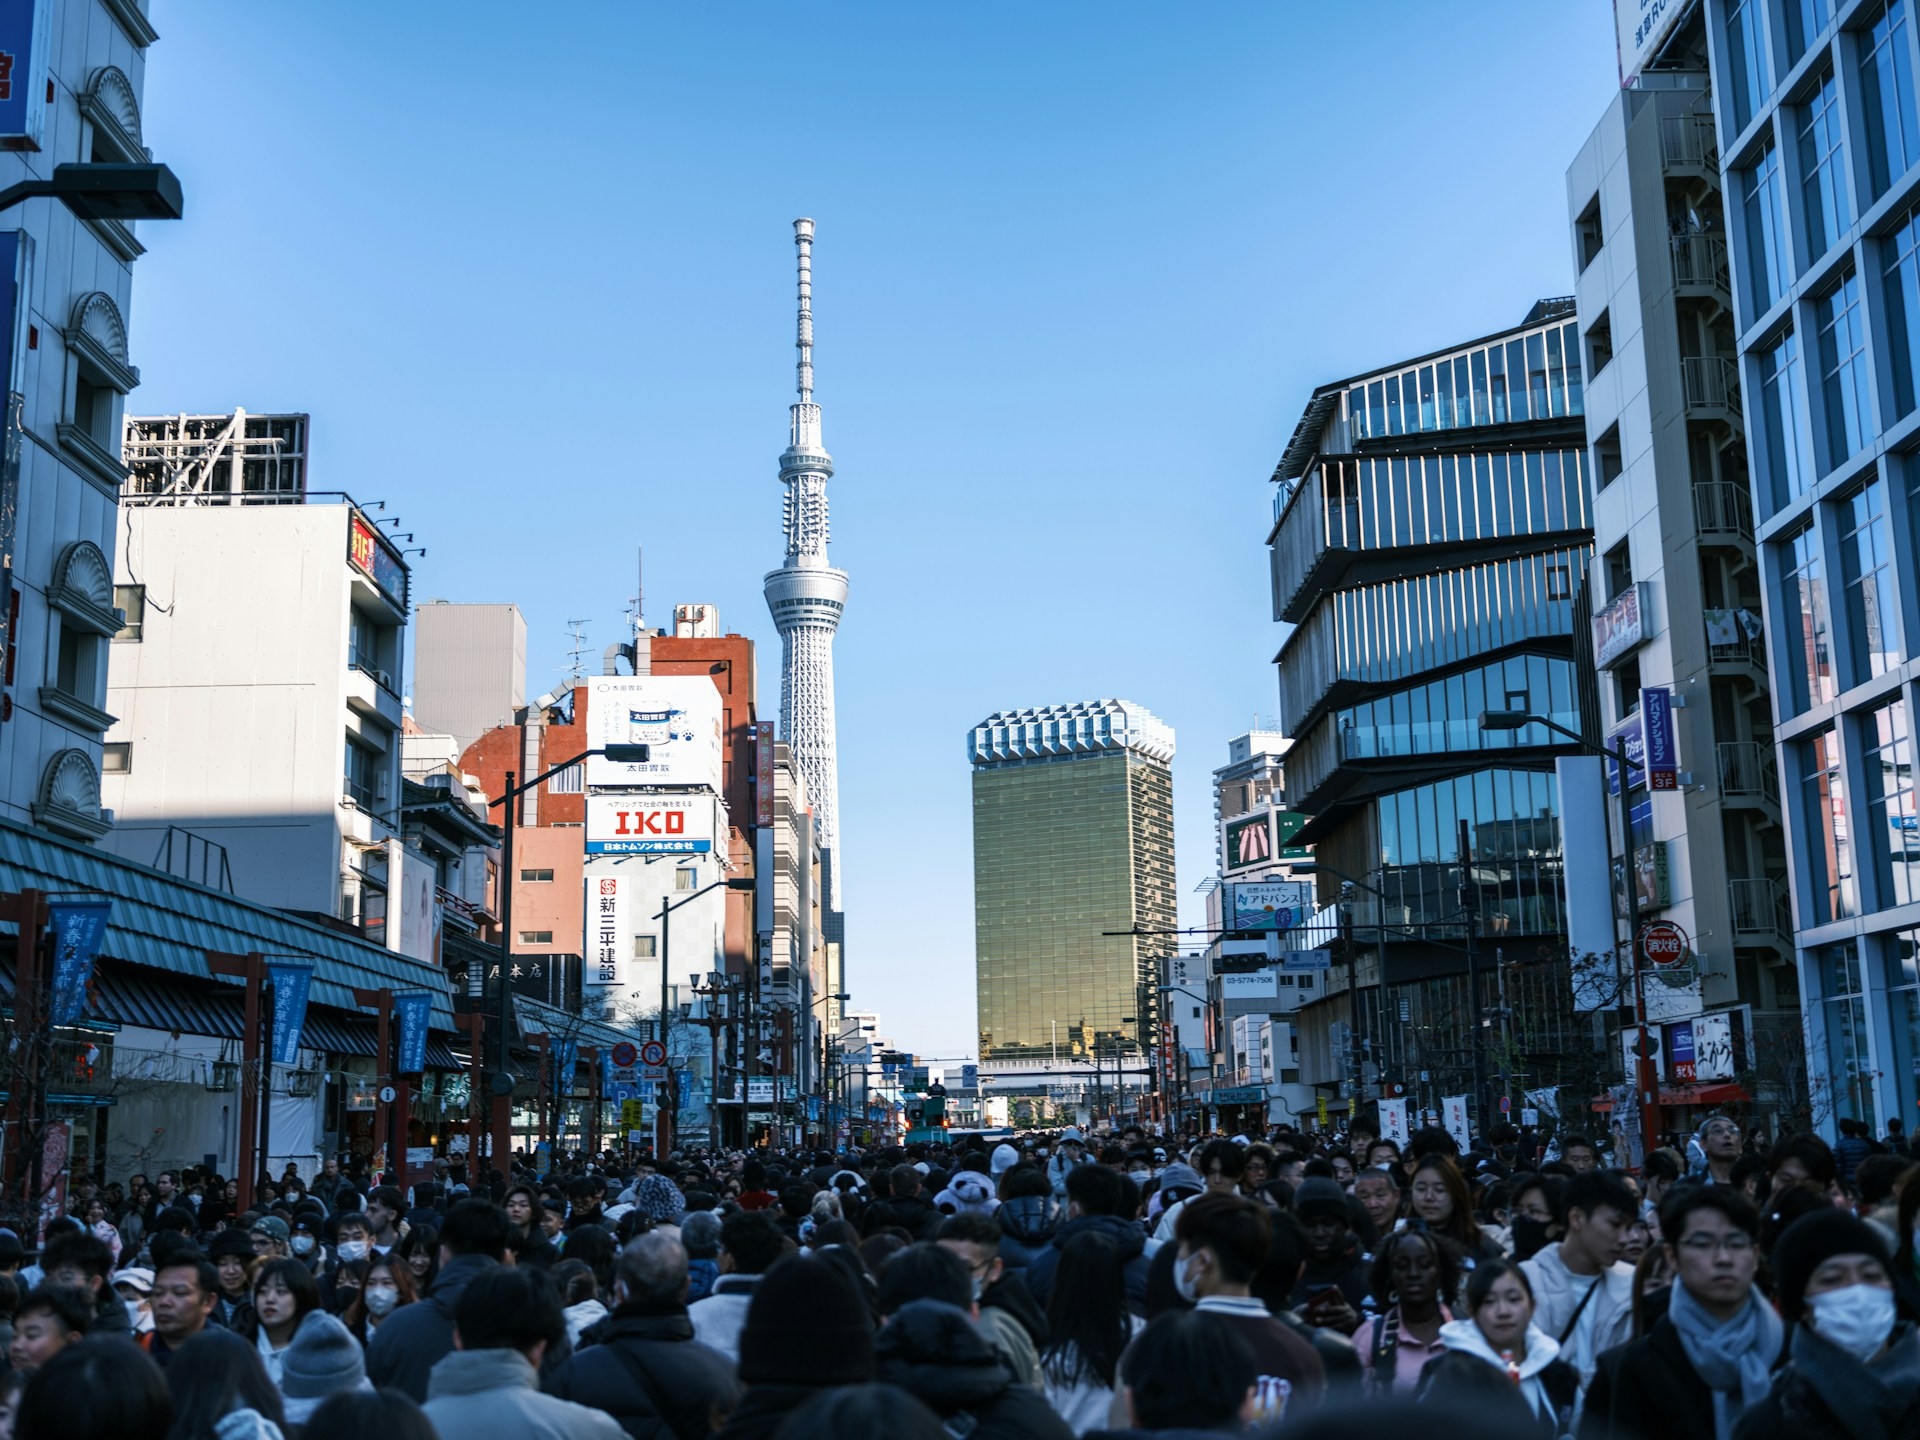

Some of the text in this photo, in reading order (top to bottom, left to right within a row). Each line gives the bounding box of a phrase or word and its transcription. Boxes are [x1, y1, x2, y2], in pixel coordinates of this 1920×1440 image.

[1635, 0, 1669, 50] 浅草RO
[634, 713, 666, 721] 太田胃散
[1648, 693, 1665, 762] アパマンショップ
[626, 764, 670, 773] 太田胃散
[760, 736, 770, 812] 浅草タウンホテル
[1655, 778, 1673, 788] 3F
[615, 811, 684, 835] IKO
[603, 842, 695, 851] 日本トムソン株式会社
[1250, 895, 1300, 904] アドバンス
[600, 897, 616, 981] 新三平建設
[1647, 939, 1679, 953] 消火栓
